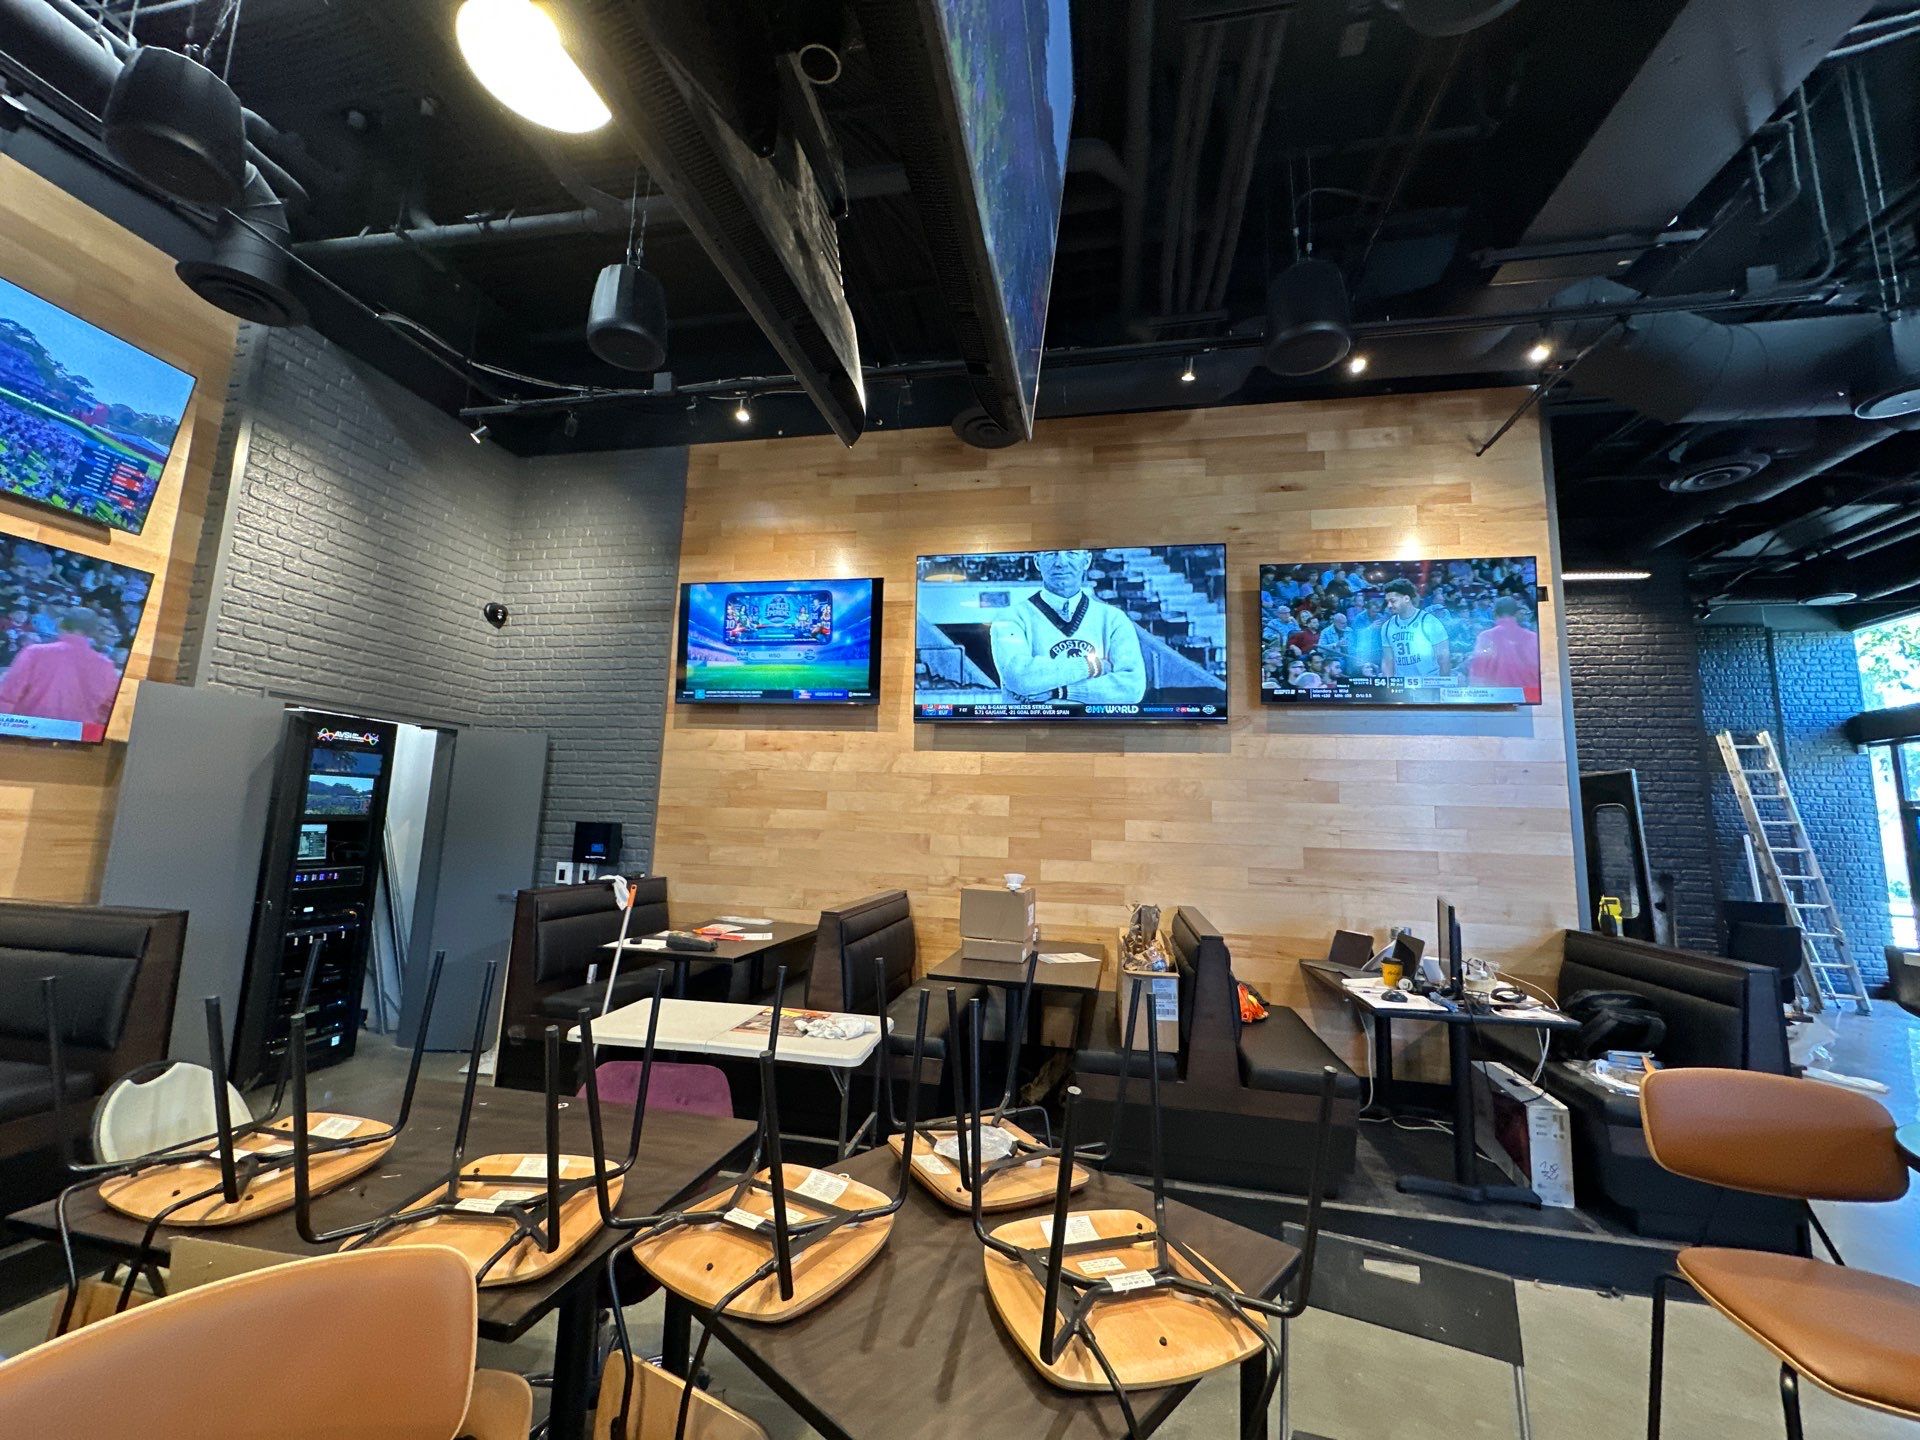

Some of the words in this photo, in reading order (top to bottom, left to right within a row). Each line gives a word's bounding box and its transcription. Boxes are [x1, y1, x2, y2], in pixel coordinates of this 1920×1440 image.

[1392, 631, 1414, 643] SOUTH
[1052, 640, 1094, 655] BOSTON
[1397, 642, 1411, 656] 31
[1395, 654, 1421, 665] AROLINA
[1374, 678, 1386, 687] 54
[1407, 678, 1419, 686] 55
